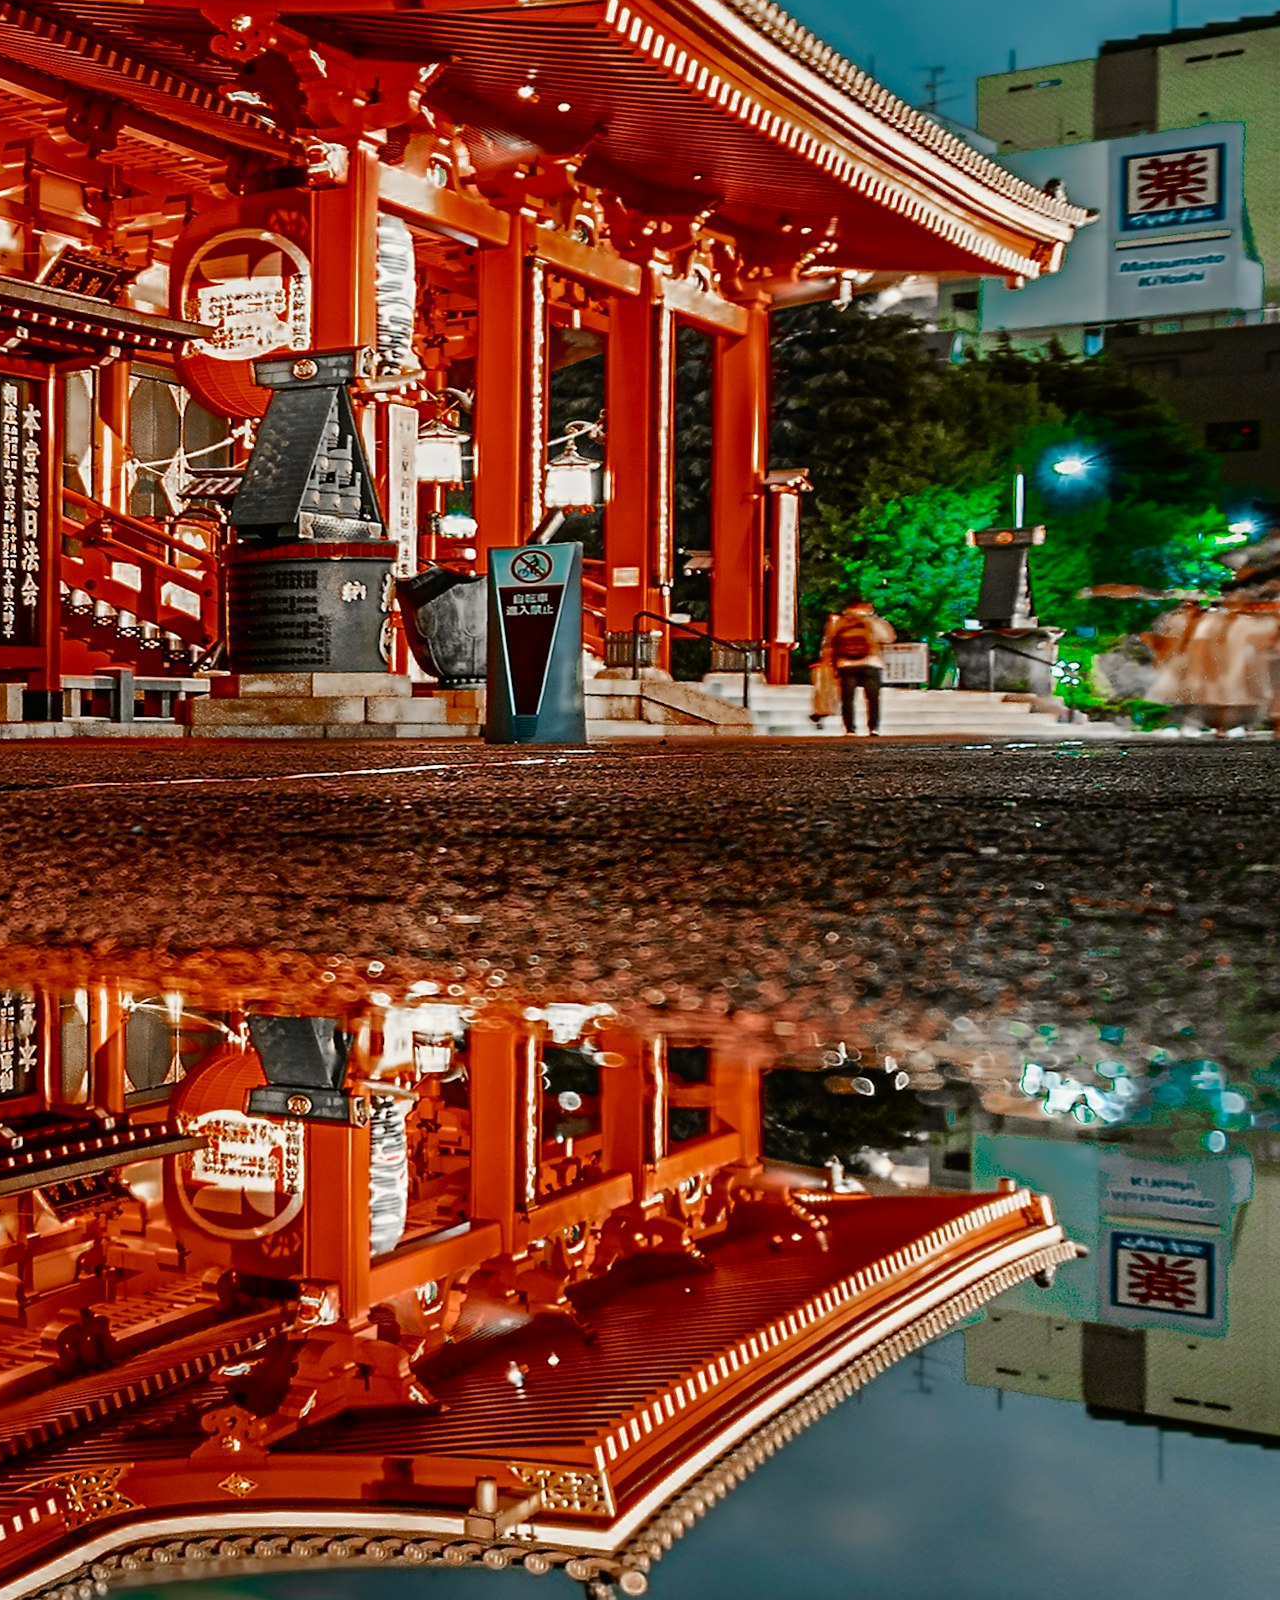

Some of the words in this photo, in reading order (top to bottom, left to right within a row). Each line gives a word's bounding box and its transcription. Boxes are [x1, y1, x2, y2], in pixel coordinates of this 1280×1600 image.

[1137, 153, 1208, 211] 薬
[1119, 254, 1226, 273] Matsumoto
[513, 593, 548, 604] 自転車
[506, 604, 554, 616] 進入禁止
